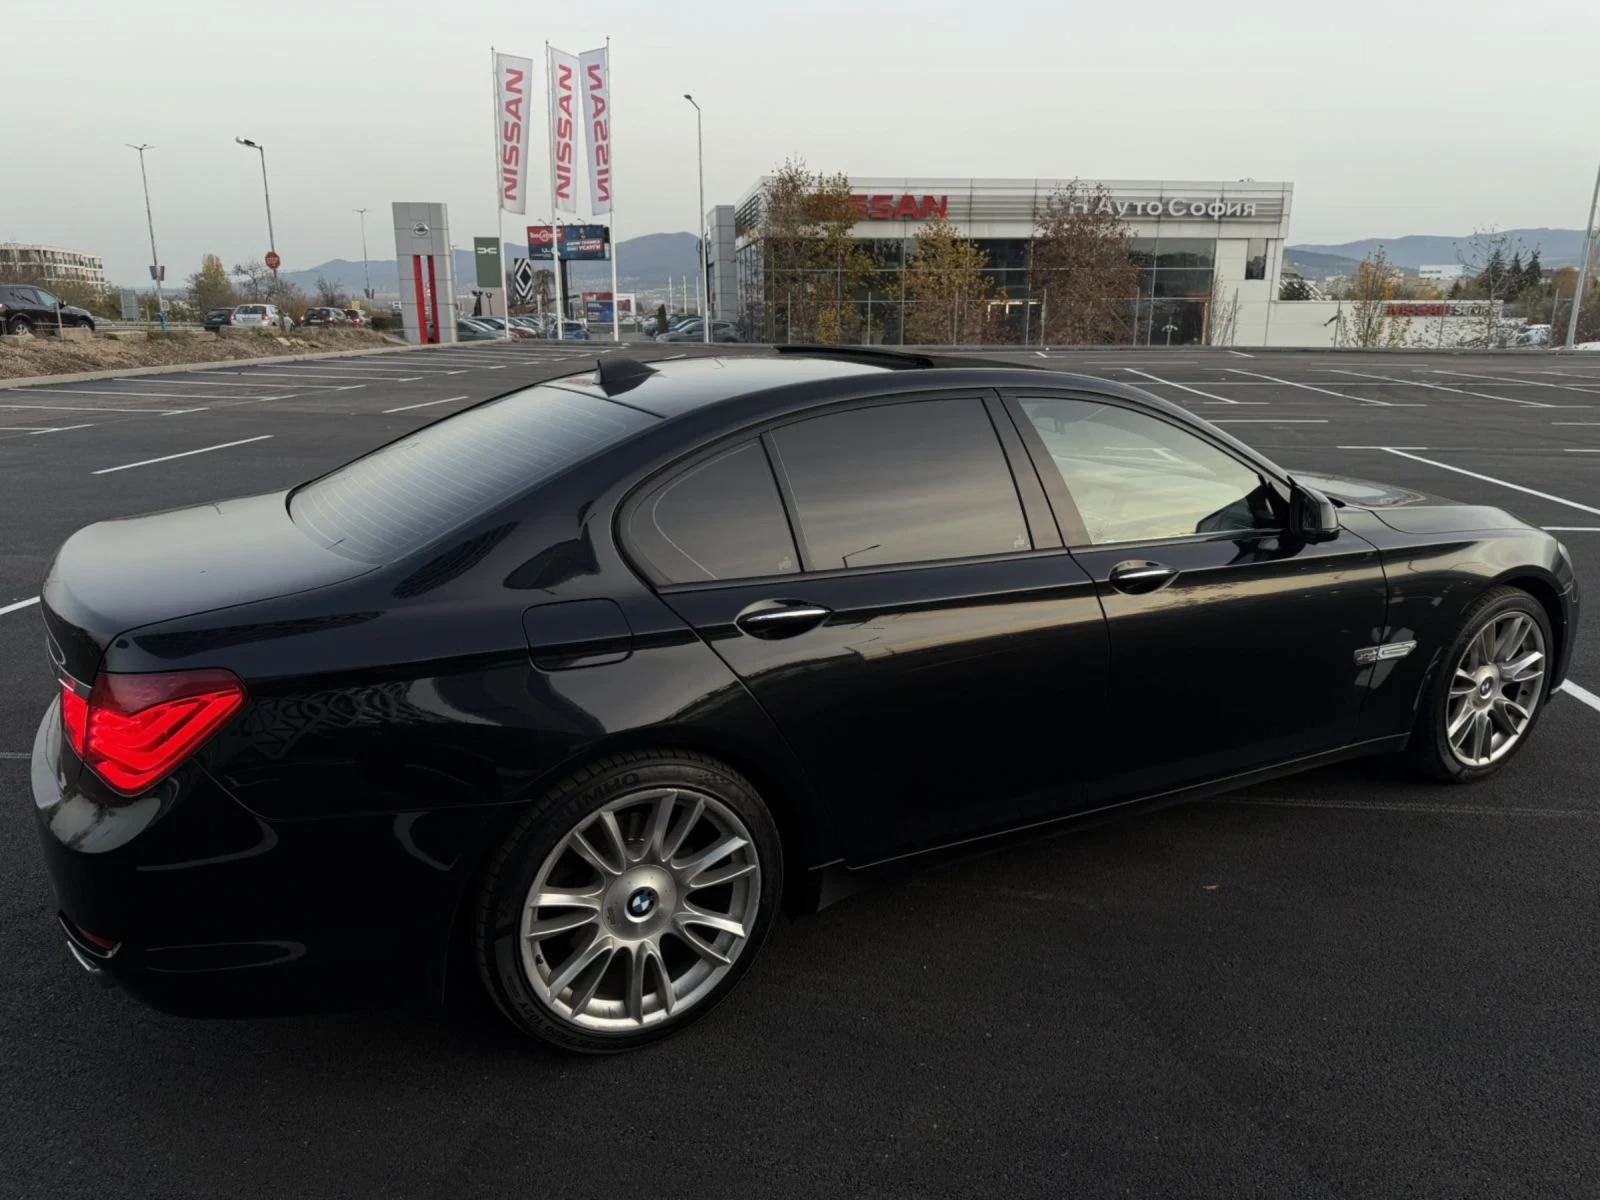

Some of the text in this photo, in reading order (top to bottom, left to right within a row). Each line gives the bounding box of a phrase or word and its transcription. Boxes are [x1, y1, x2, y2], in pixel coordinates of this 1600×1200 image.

[503, 68, 524, 201] NISSAN
[555, 64, 573, 199] NISSAN
[812, 194, 948, 219] SSAN
[1094, 196, 1163, 219] Ауто
[1168, 197, 1256, 220] София
